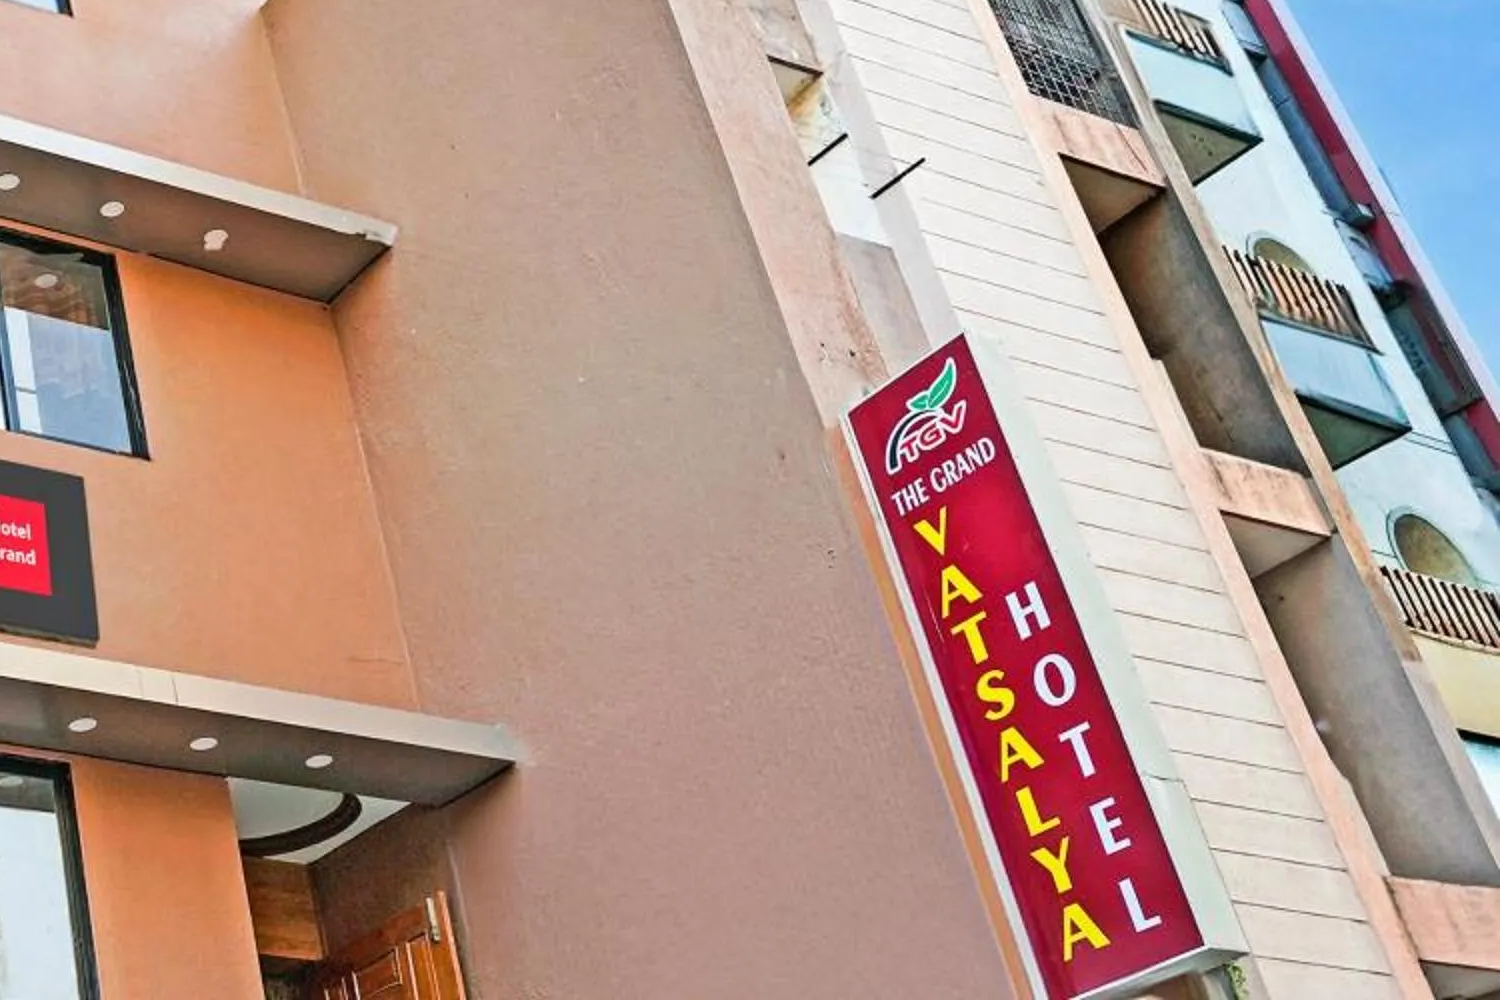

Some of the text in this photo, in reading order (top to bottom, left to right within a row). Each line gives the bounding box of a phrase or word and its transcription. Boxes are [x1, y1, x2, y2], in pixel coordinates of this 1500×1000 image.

[891, 437, 996, 516] THE GRAND
[900, 400, 967, 463] TGV
[913, 506, 1112, 962] VATSALYA
[1005, 581, 1162, 933] HOTEL
